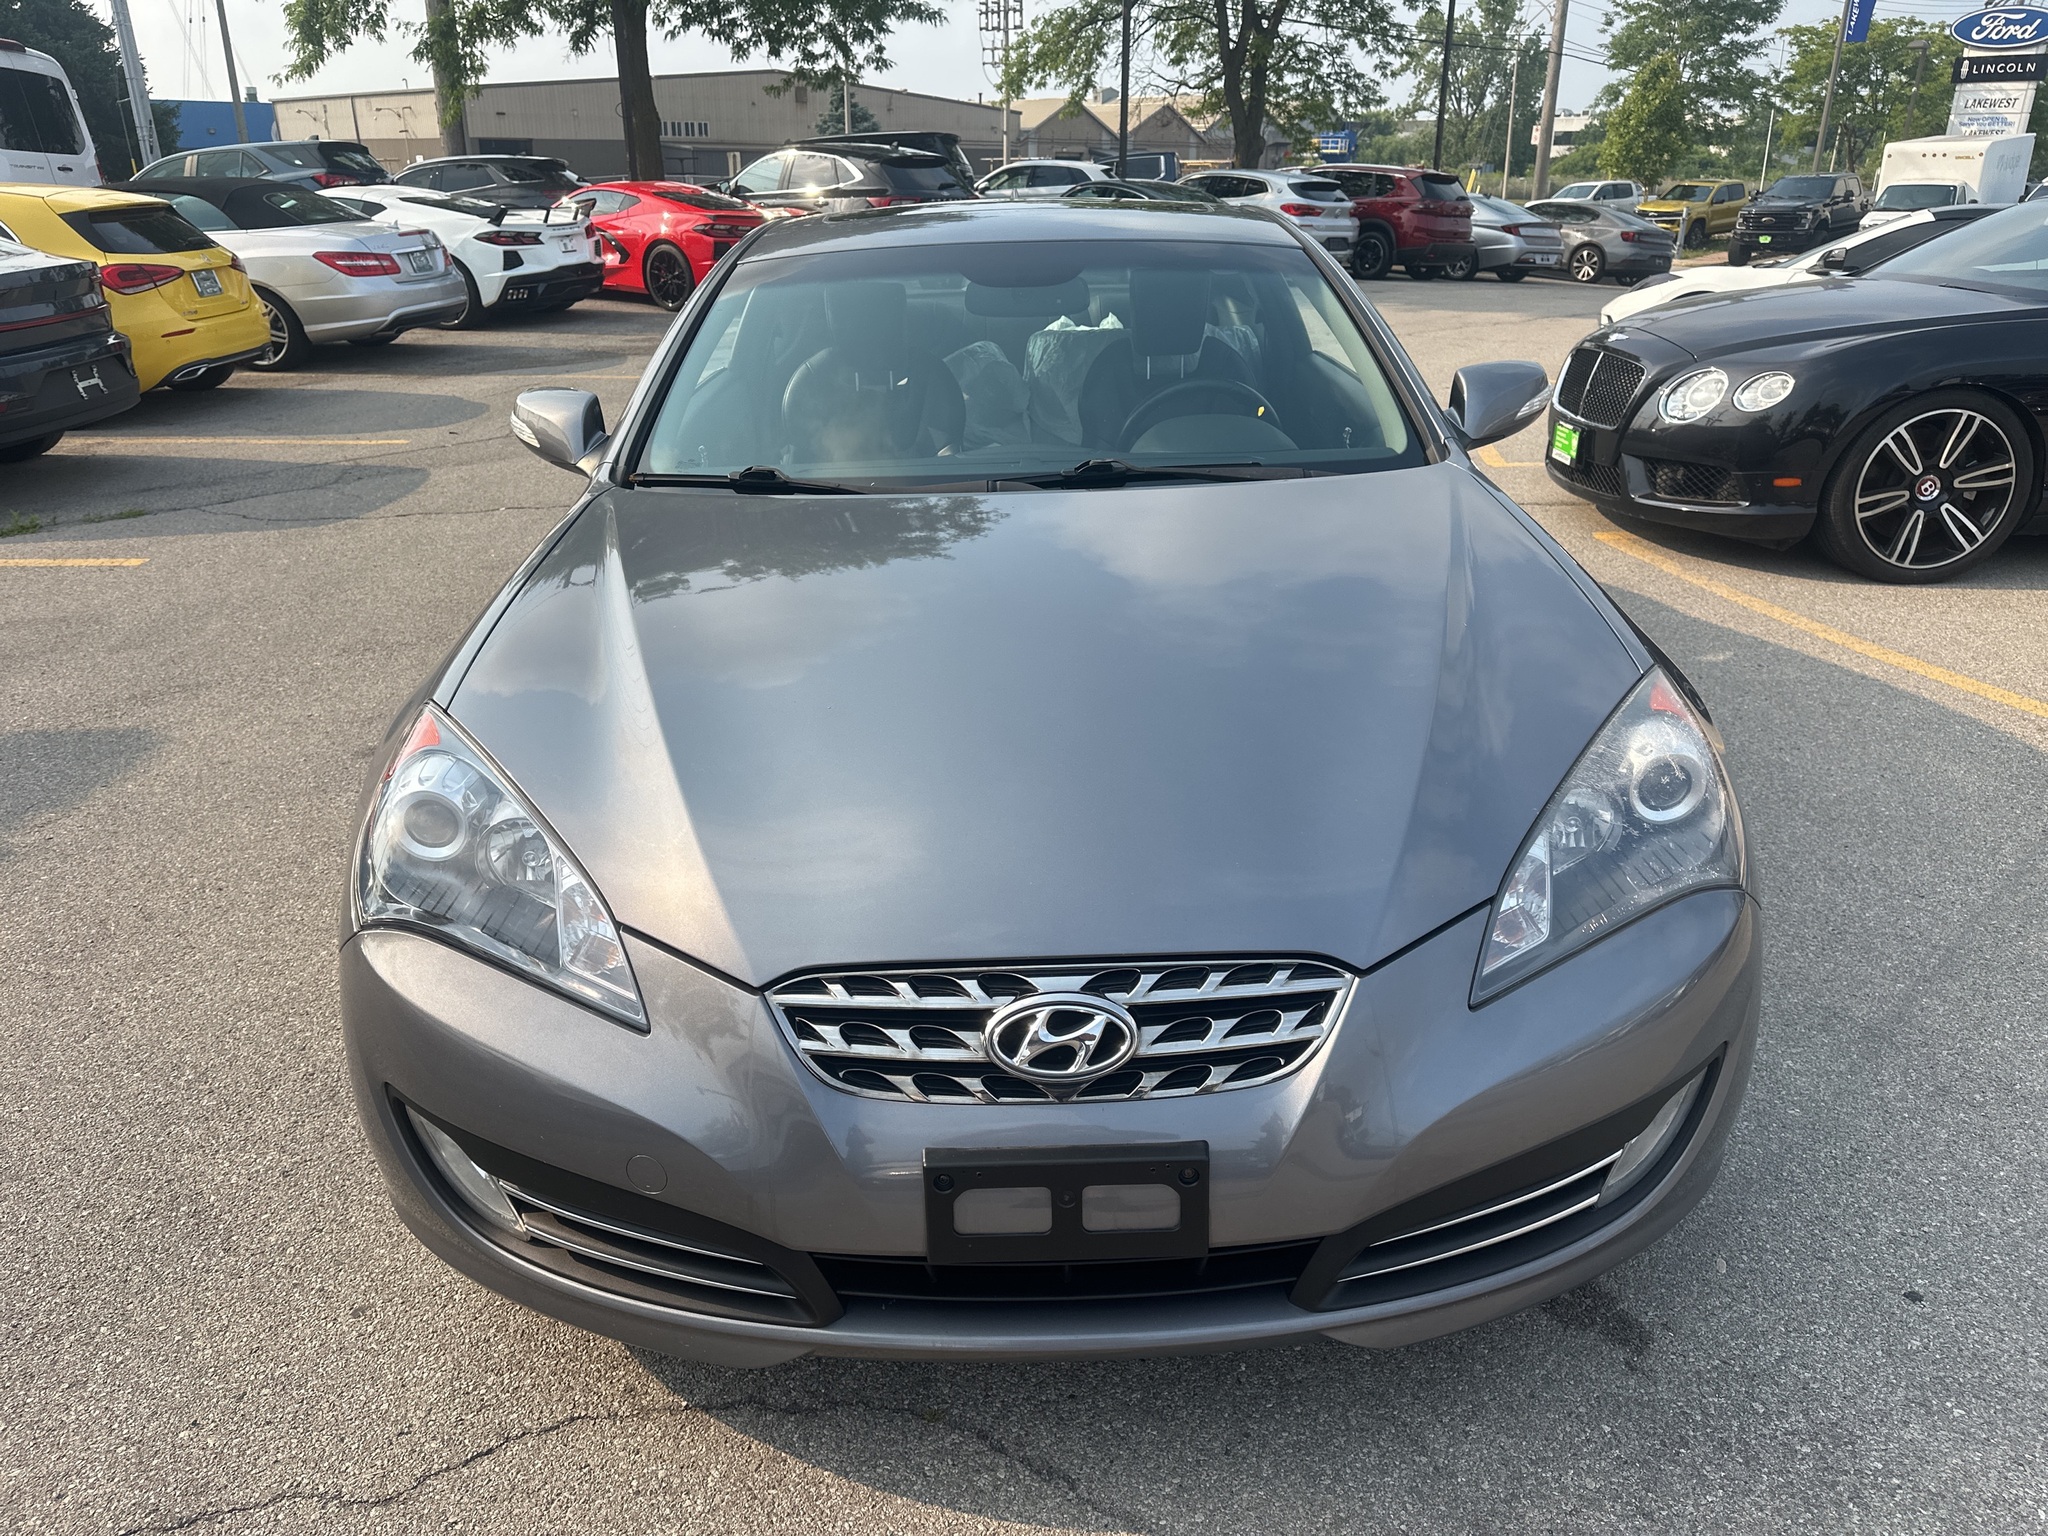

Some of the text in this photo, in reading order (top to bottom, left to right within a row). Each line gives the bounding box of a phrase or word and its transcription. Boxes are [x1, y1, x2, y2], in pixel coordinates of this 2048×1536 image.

[1971, 12, 2042, 40] Ford
[1972, 62, 2036, 75] LINCOLN
[1964, 97, 2019, 109] LAKEWEST
